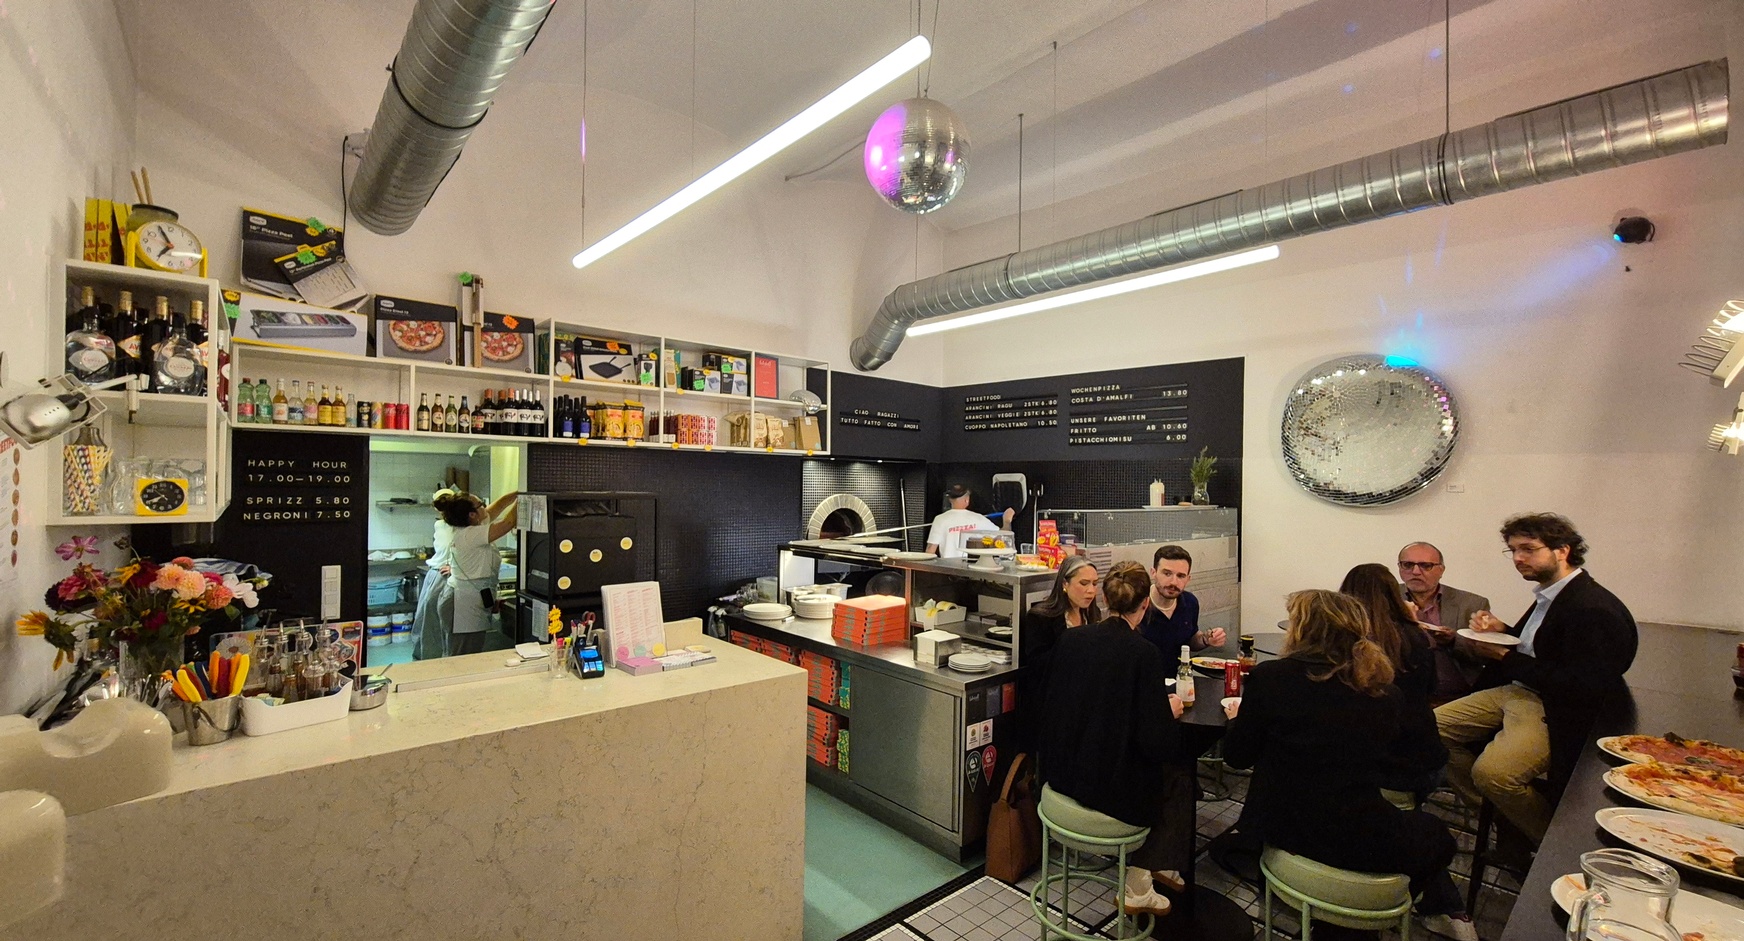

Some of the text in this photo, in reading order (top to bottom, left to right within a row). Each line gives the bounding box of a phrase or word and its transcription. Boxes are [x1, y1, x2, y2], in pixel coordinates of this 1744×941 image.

[1071, 384, 1120, 394] WOCHENPIZZA
[966, 394, 1001, 403] STREETFOOD
[1096, 394, 1133, 402] D'AMALFI
[1162, 389, 1188, 397] 13.80
[1104, 414, 1146, 422] FAVORITEN
[990, 421, 1028, 429] NAPOLETANO
[247, 459, 347, 469] HAPPY HOUR
[246, 496, 350, 505] SPRIZZ 5.80
[243, 510, 351, 520] NEGRONI 7.50
